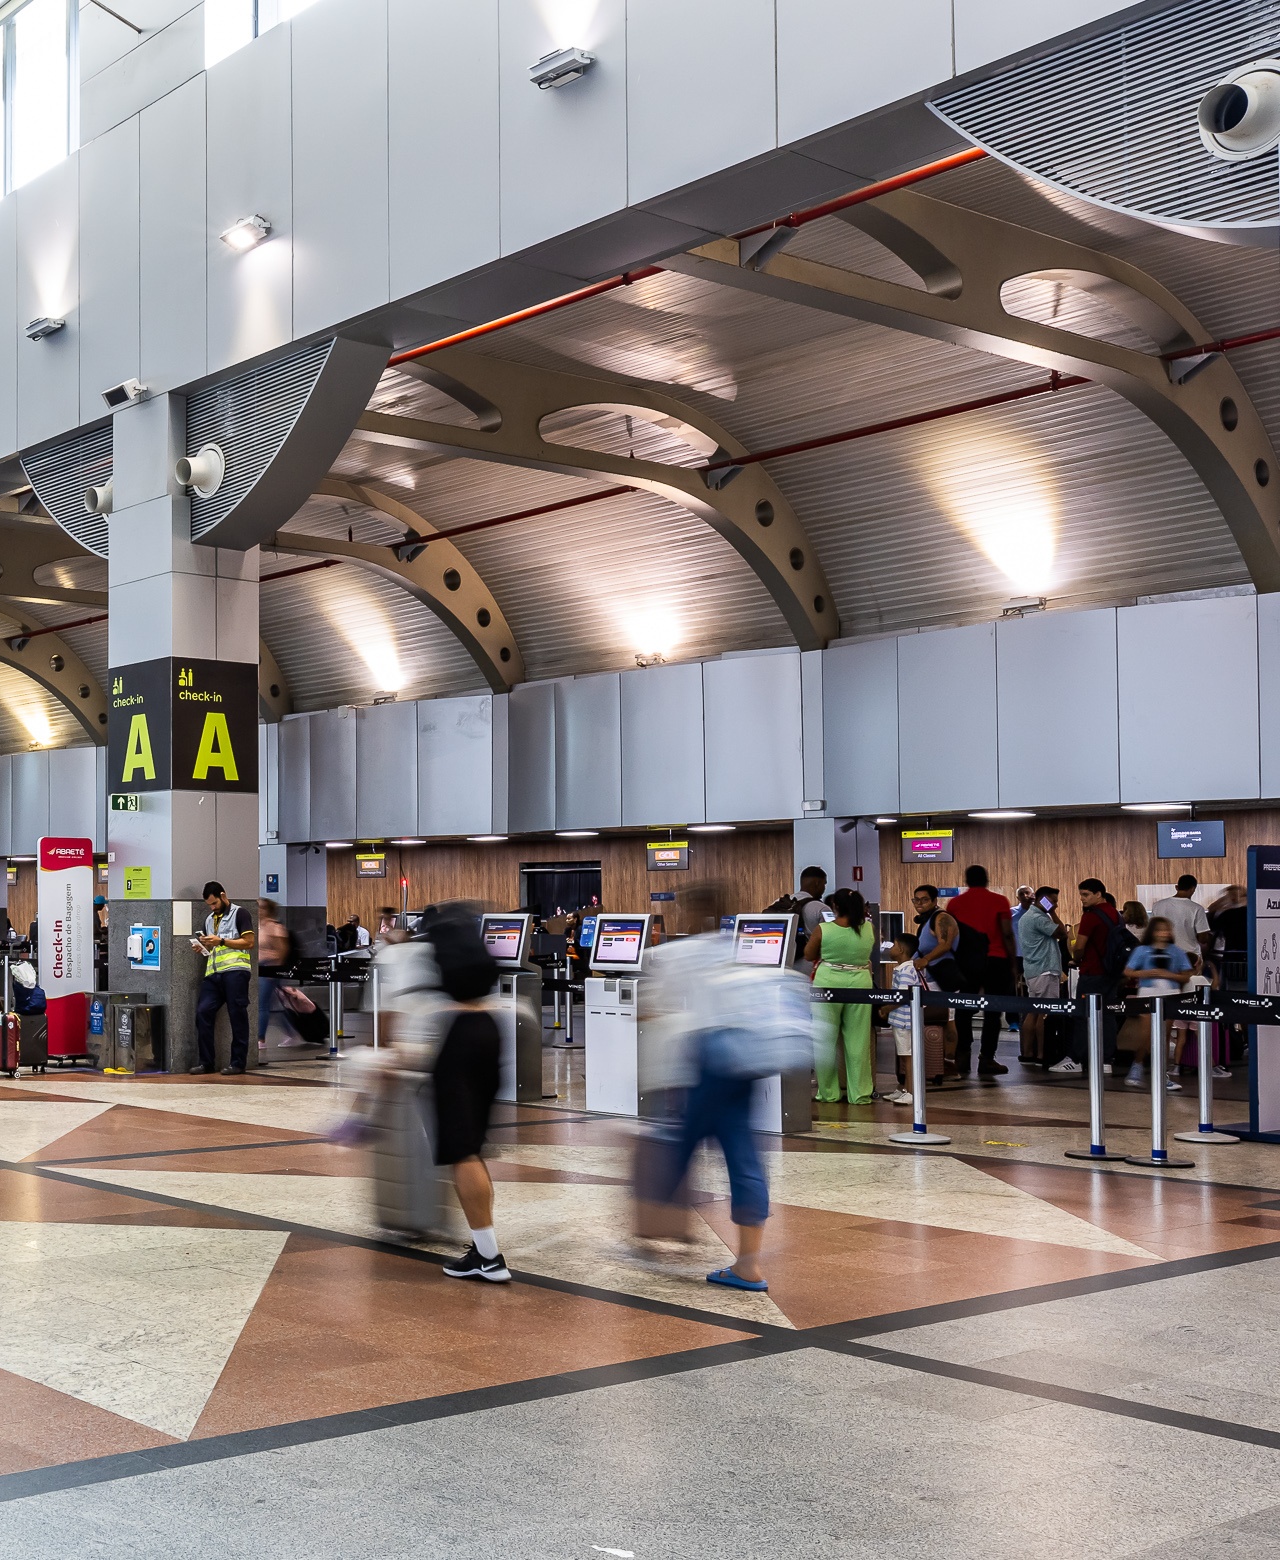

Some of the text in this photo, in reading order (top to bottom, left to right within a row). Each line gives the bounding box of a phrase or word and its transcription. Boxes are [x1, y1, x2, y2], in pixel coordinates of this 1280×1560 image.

[112, 694, 144, 708] check-in
[179, 690, 222, 702] check-in
[121, 713, 156, 782] A
[192, 712, 240, 781] A
[658, 851, 677, 859] GOL
[53, 919, 63, 979] Check-In
[66, 883, 74, 979] Despacho de Bagagem
[1232, 998, 1260, 1006] VINCI
